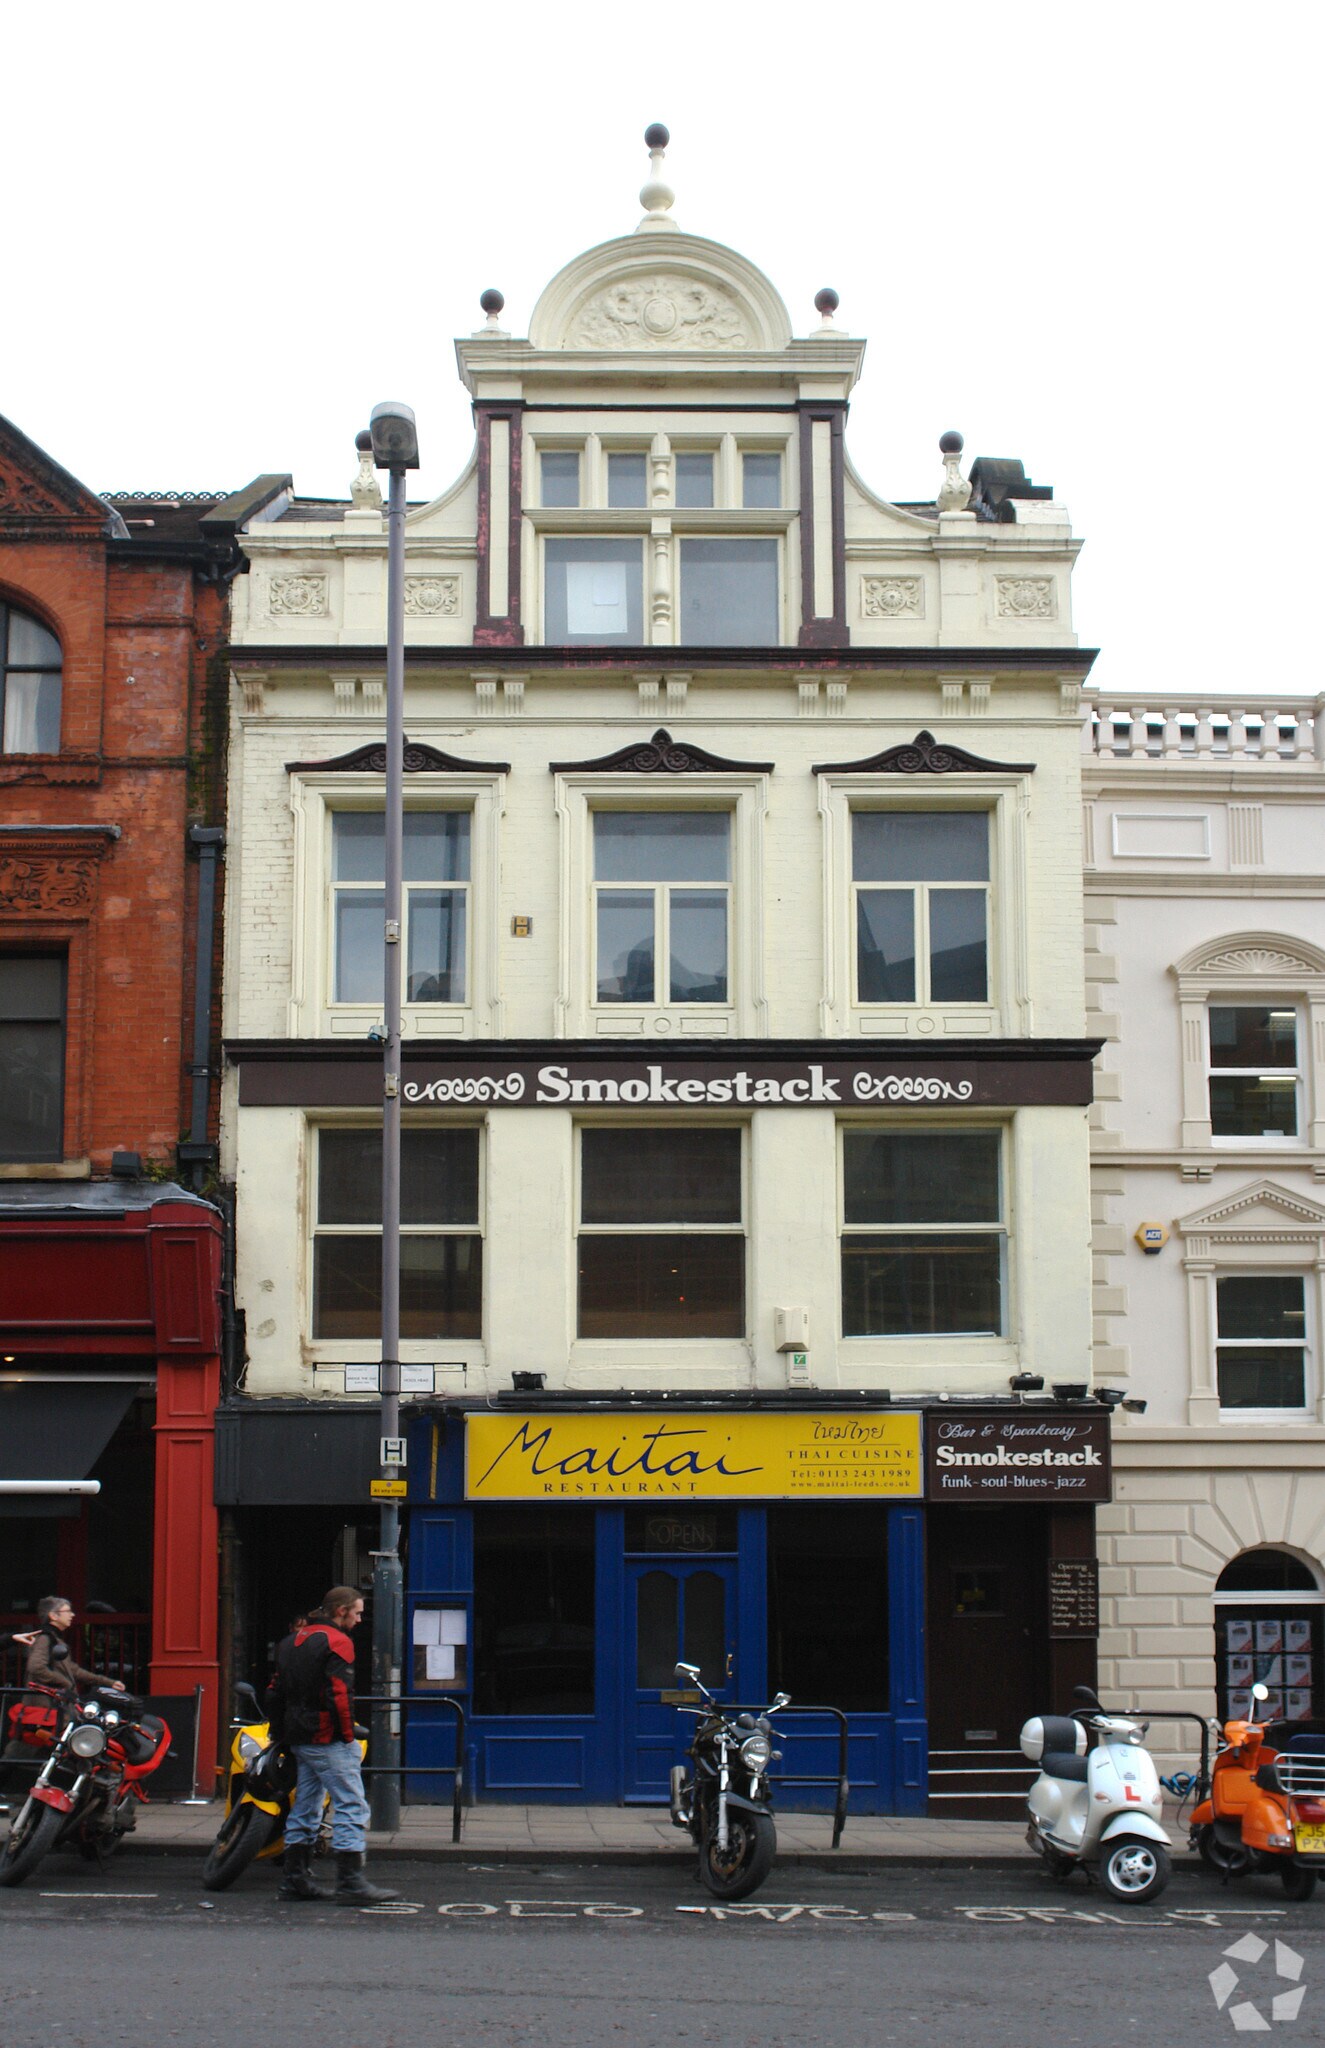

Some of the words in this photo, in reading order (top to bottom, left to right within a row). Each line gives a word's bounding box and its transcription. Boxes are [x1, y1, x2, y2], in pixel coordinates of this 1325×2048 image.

[536, 1065, 842, 1102] Smokestack
[811, 1420, 887, 1444] ไหมไทย
[938, 1422, 976, 1439] Bar
[980, 1424, 995, 1437] &
[1001, 1423, 1092, 1441] Speakeasy
[475, 1420, 764, 1488] Maitai
[786, 1449, 831, 1459] THAI
[839, 1449, 915, 1459] CUISINE
[936, 1444, 1103, 1467] Smokestack
[854, 1469, 876, 1479] 243
[881, 1469, 912, 1479] 1989
[543, 1481, 698, 1493] RESTAURANT
[790, 1480, 911, 1488] www.maitai-leeds.co.uk
[1124, 1785, 1142, 1802] L
[1302, 1837, 1325, 1850] PZ
[359, 1900, 645, 1918] SOLO
[964, 1909, 1222, 1927] ONLY
